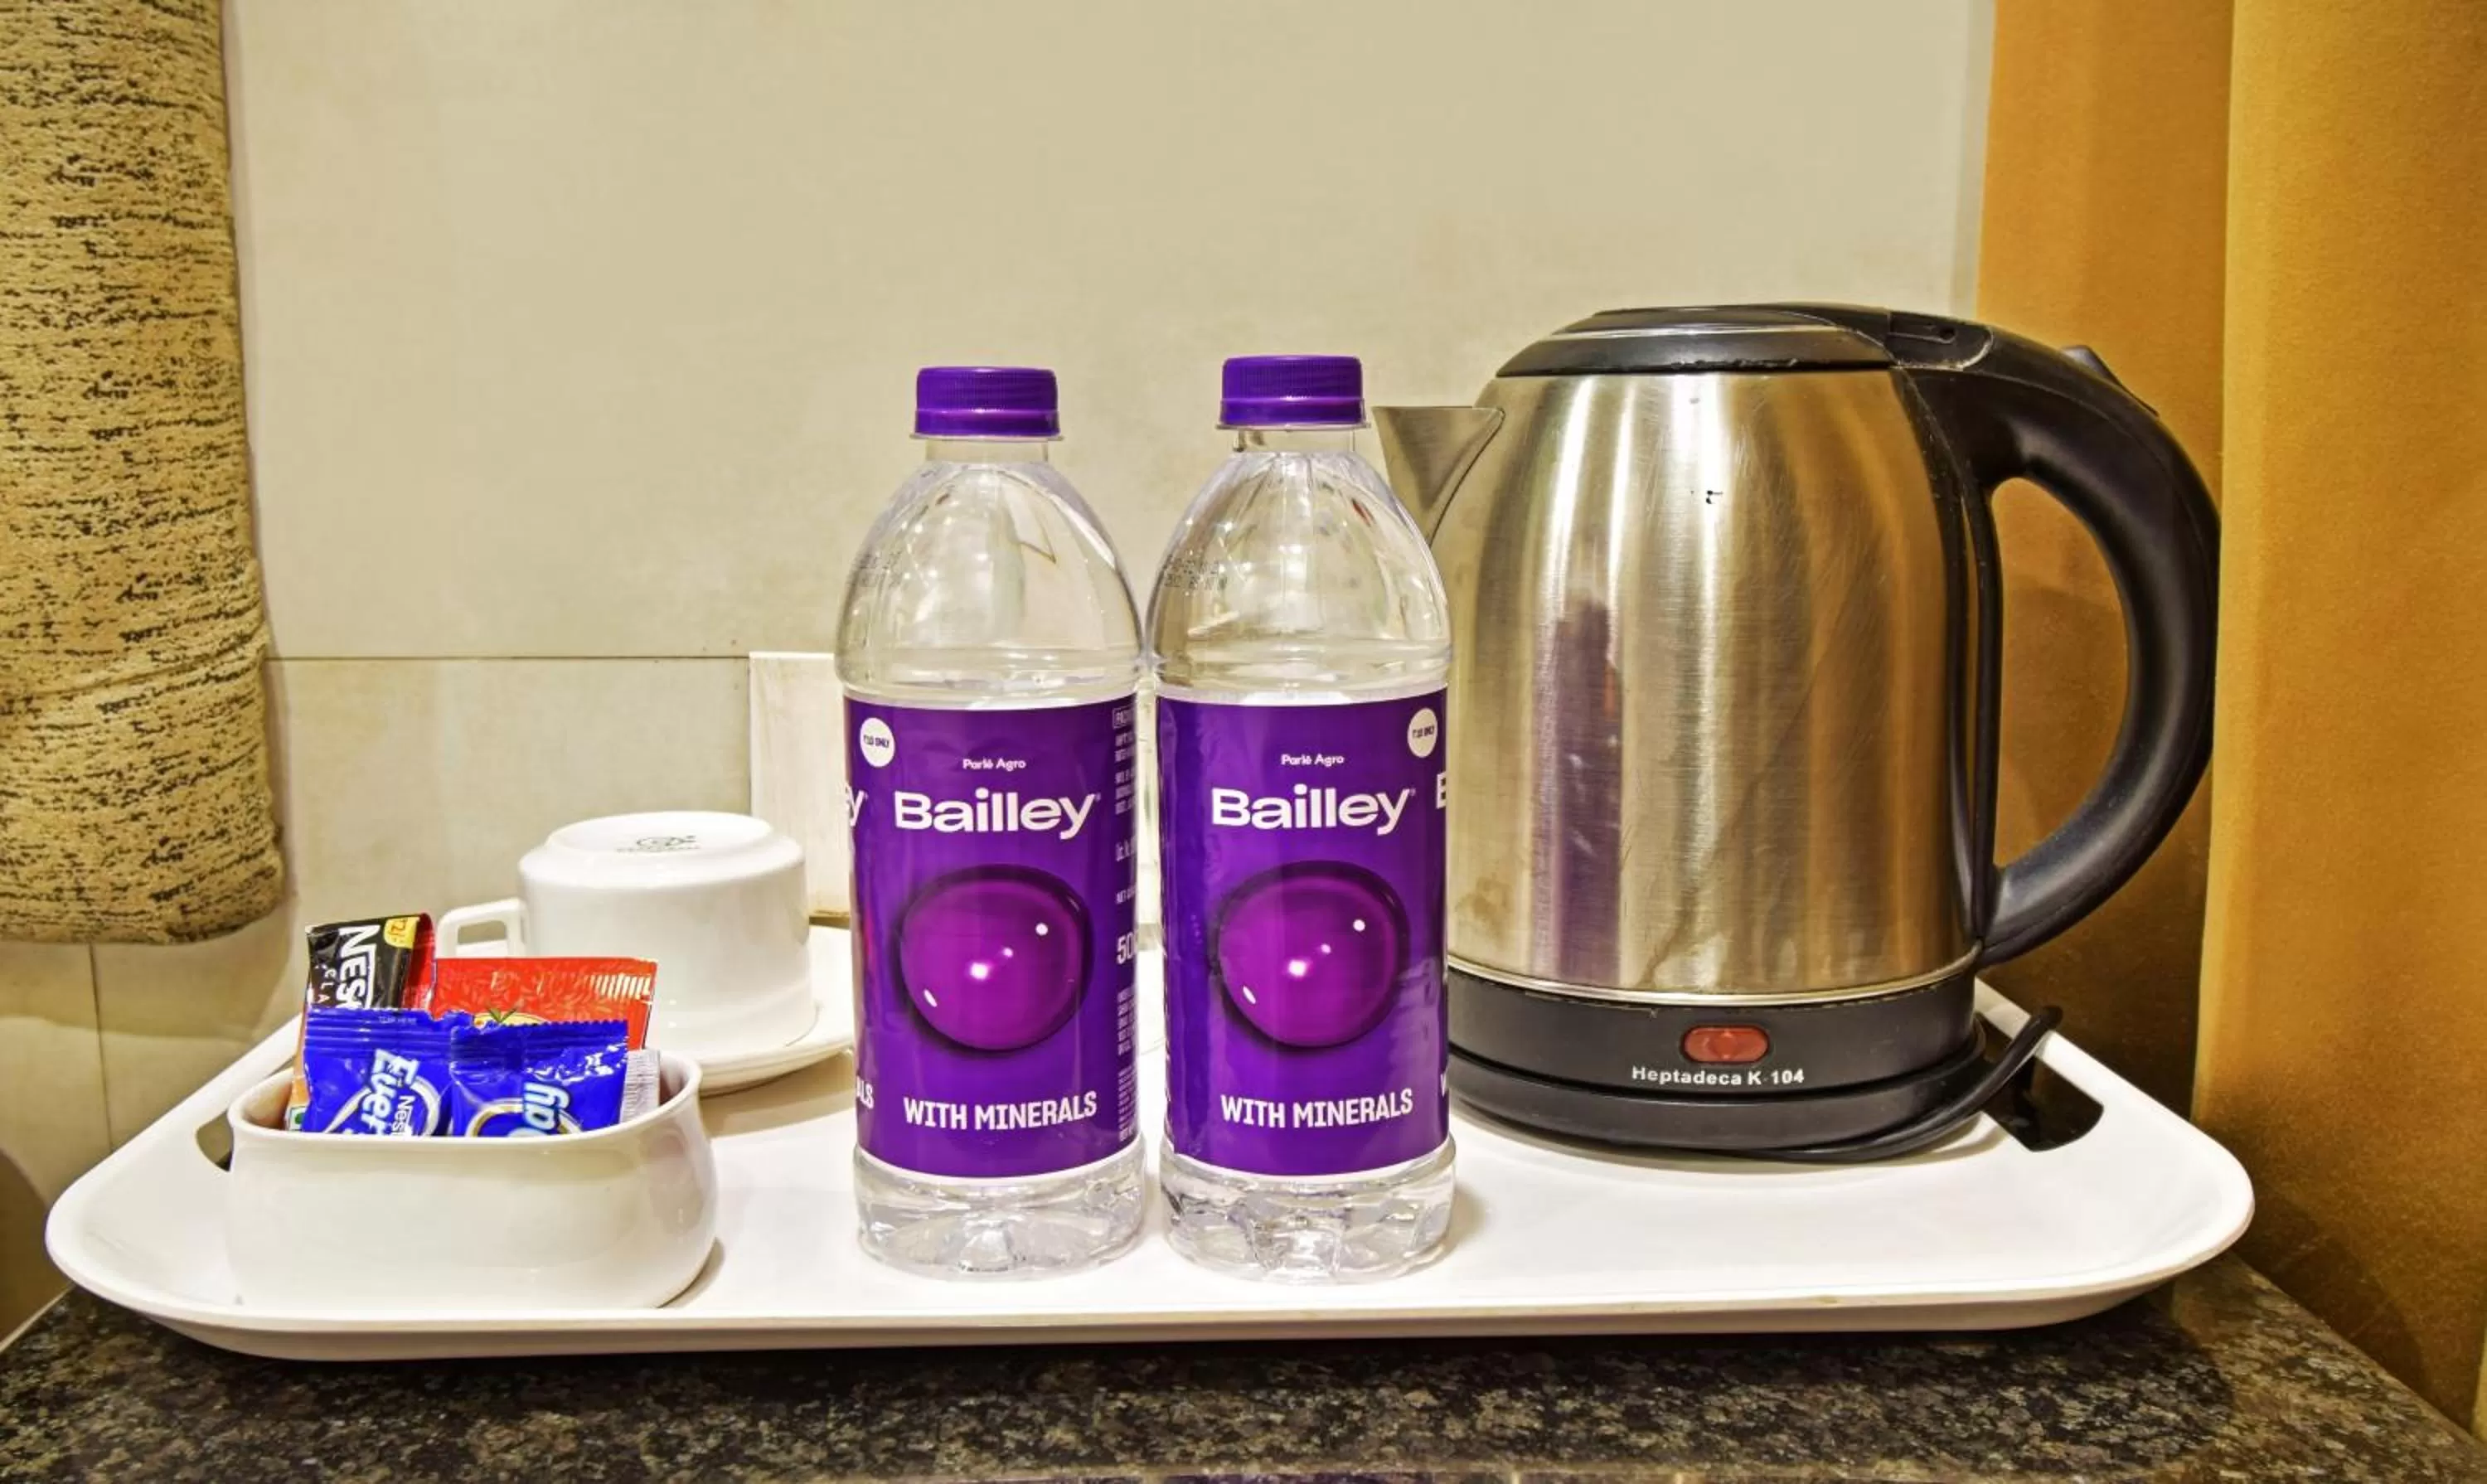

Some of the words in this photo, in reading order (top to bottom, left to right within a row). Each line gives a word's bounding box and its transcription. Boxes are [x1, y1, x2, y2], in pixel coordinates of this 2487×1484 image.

[996, 758, 1027, 772] Agro
[1314, 753, 1345, 768] Agro
[894, 787, 1097, 841] Bailley
[1211, 783, 1411, 837] Bailley
[335, 924, 381, 1009] NES
[1631, 1065, 1742, 1086] Heptadeca
[903, 1096, 967, 1130] WITH
[973, 1089, 1098, 1131] MINERALS
[1220, 1094, 1285, 1128] WITH
[1292, 1088, 1413, 1128] MINERALS
